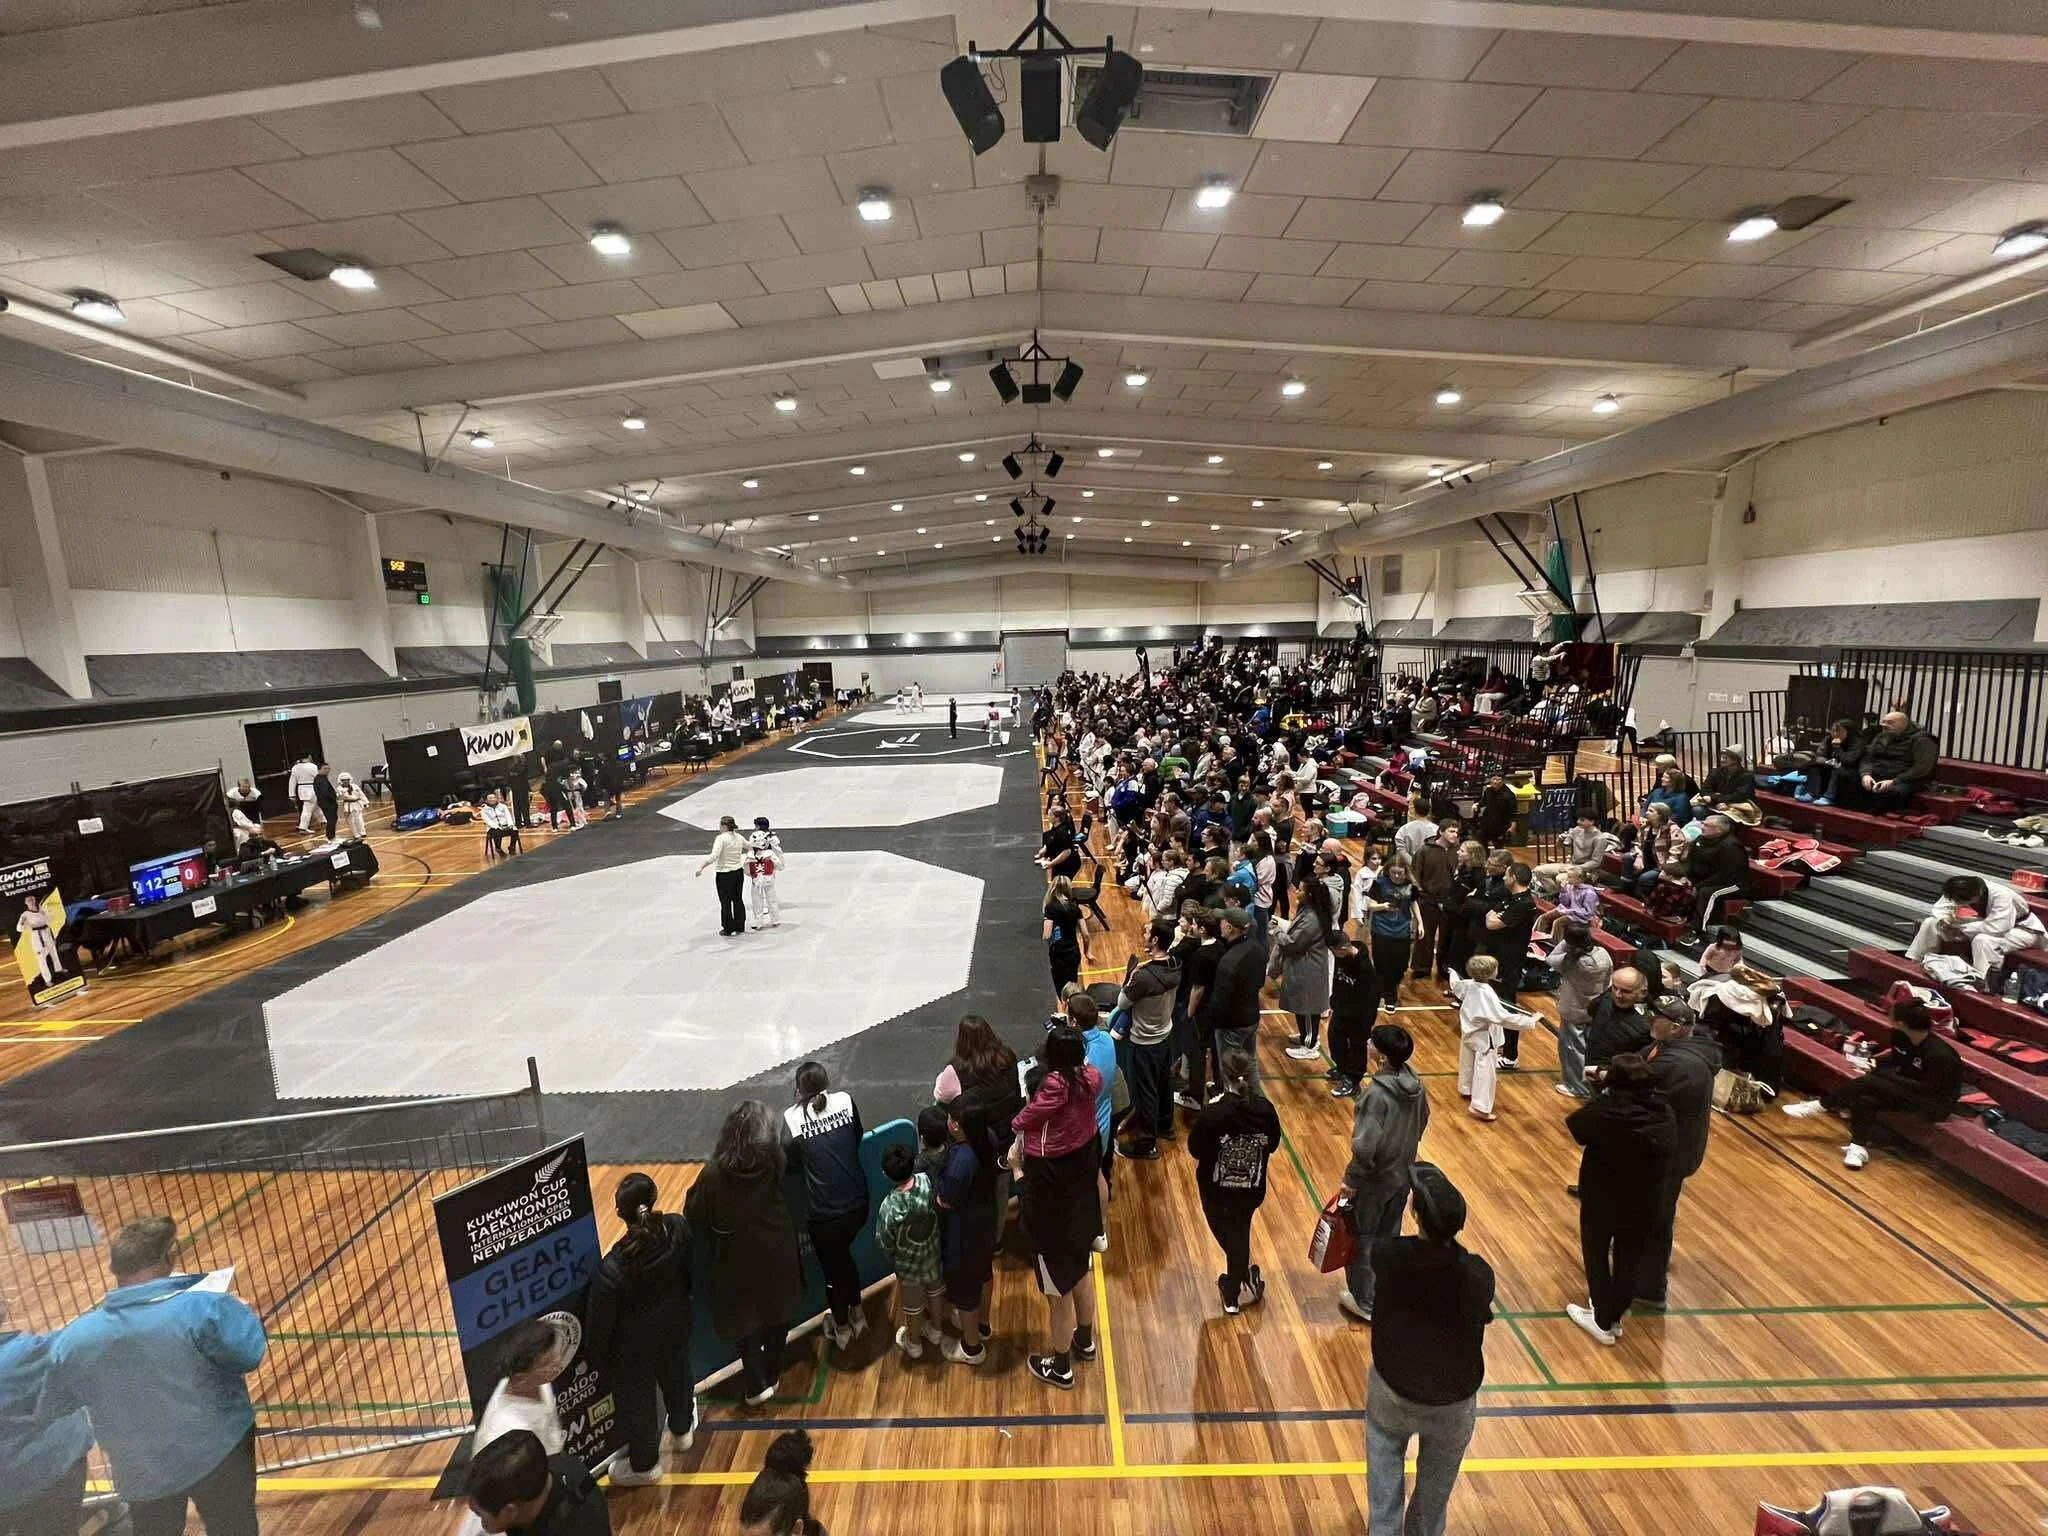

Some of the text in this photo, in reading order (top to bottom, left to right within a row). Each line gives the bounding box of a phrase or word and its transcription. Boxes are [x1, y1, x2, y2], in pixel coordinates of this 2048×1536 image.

[466, 730, 513, 755] KWON
[145, 877, 164, 892] 12
[184, 868, 194, 880] 0
[466, 1177, 567, 1231] KUKKIWON CUP
[468, 1189, 569, 1242] TAEKWONDO
[470, 1199, 571, 1252] INTERNATIONAL OPEN
[472, 1208, 572, 1264] NEW ZEALAND
[476, 1254, 589, 1330] CHECK
[484, 1237, 574, 1296] GEAR
[558, 1385, 597, 1415] ALAND
[568, 1419, 615, 1455] ALAND
